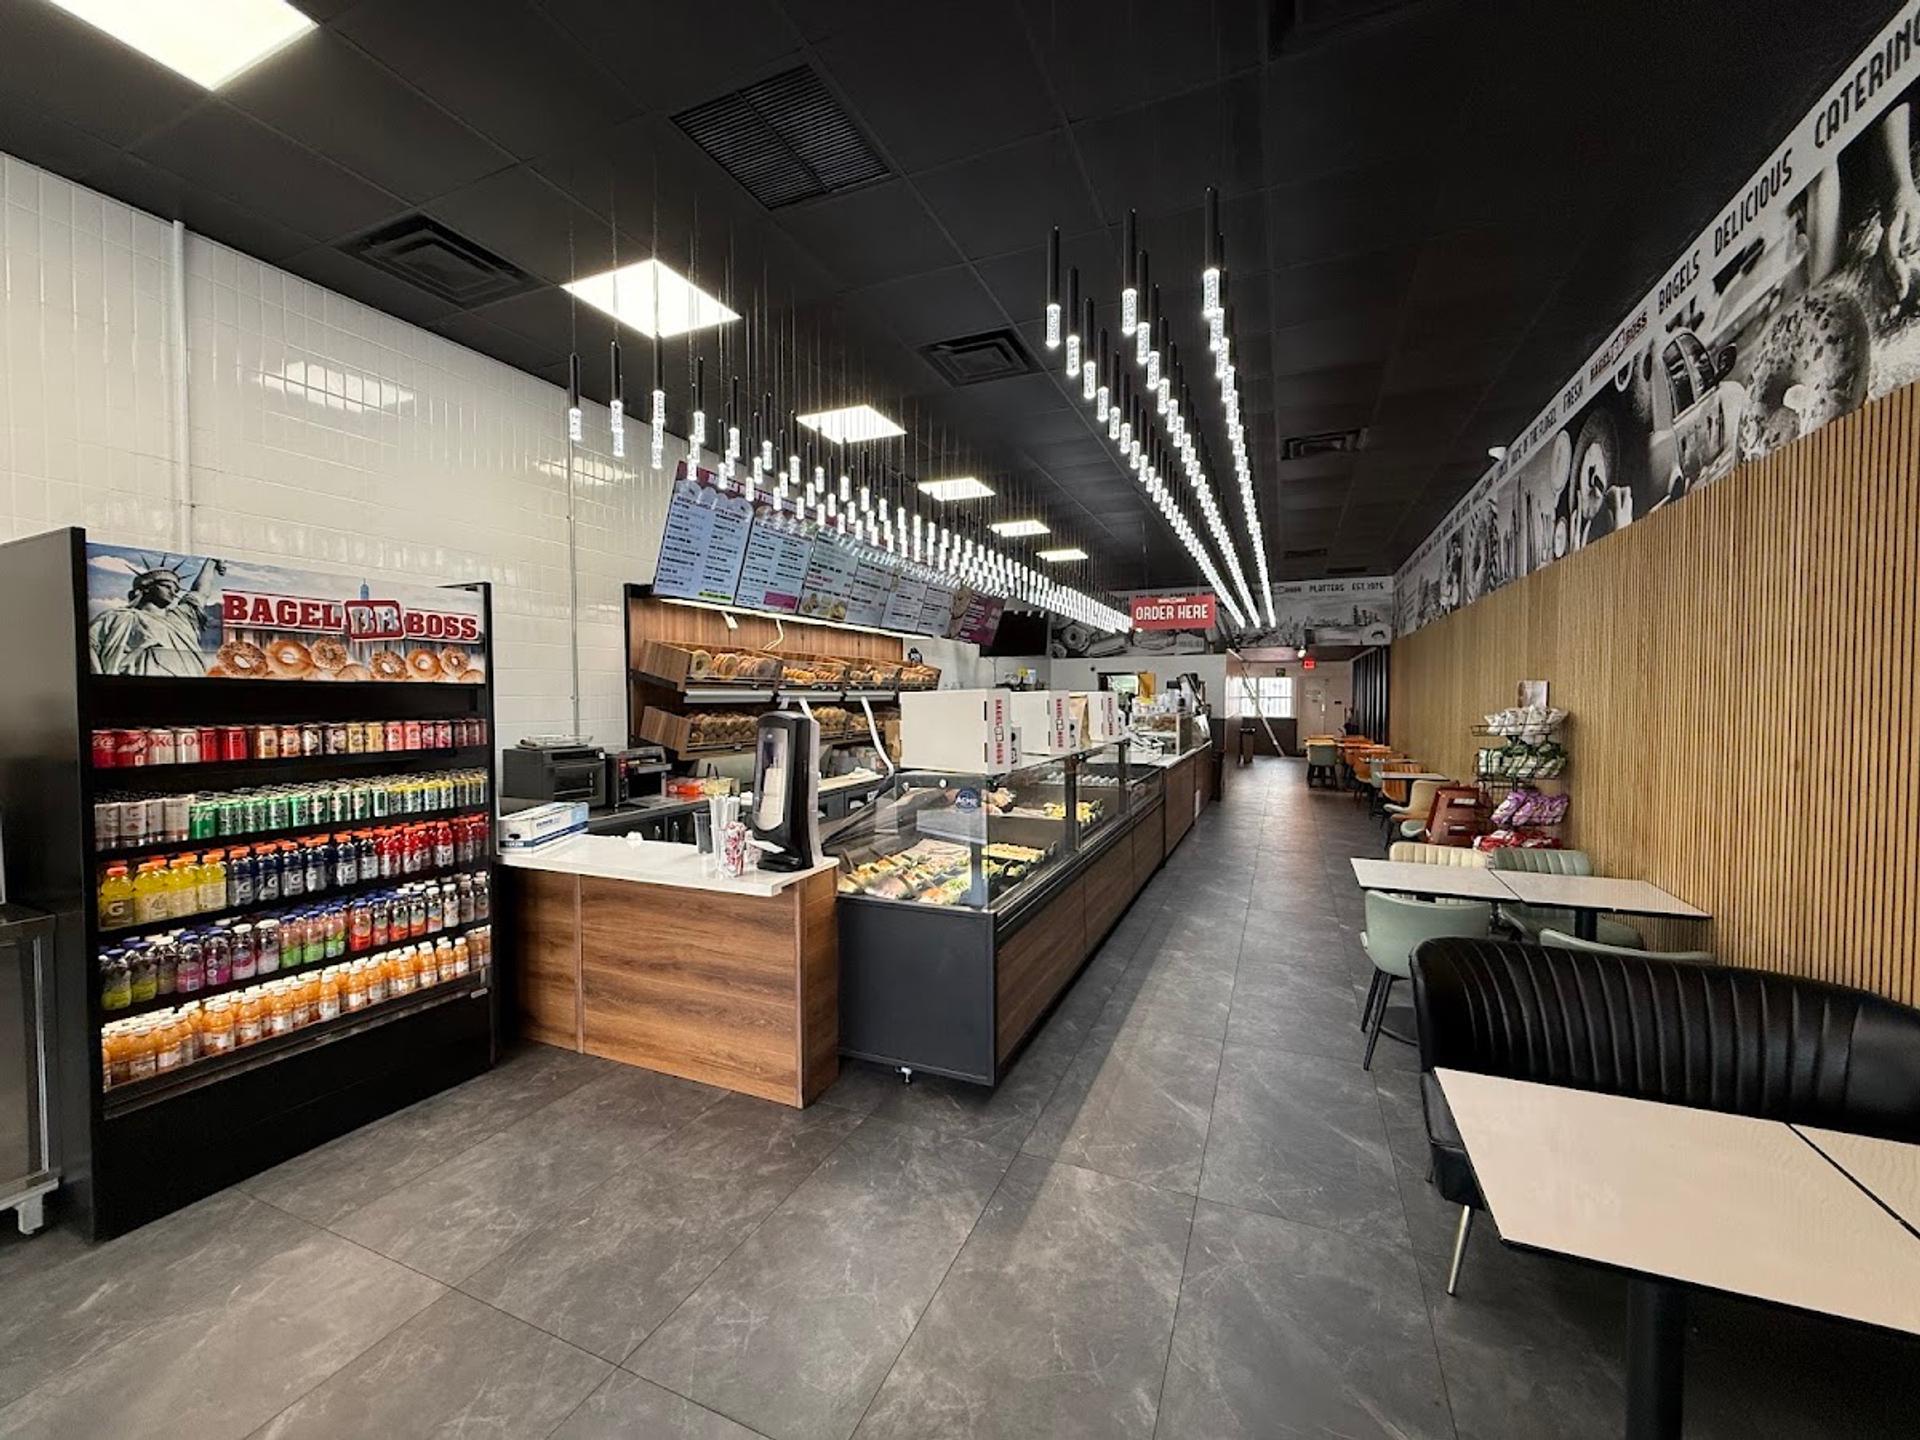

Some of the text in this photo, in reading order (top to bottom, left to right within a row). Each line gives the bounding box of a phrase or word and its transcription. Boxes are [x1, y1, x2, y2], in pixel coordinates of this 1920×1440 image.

[1659, 249, 1700, 315] BAGELS
[1714, 147, 1793, 257] DELICIOUS
[222, 593, 342, 629] BAGEL
[404, 612, 478, 640] BOSS
[1135, 603, 1209, 621] ORDER HERE
[107, 900, 125, 917] G
